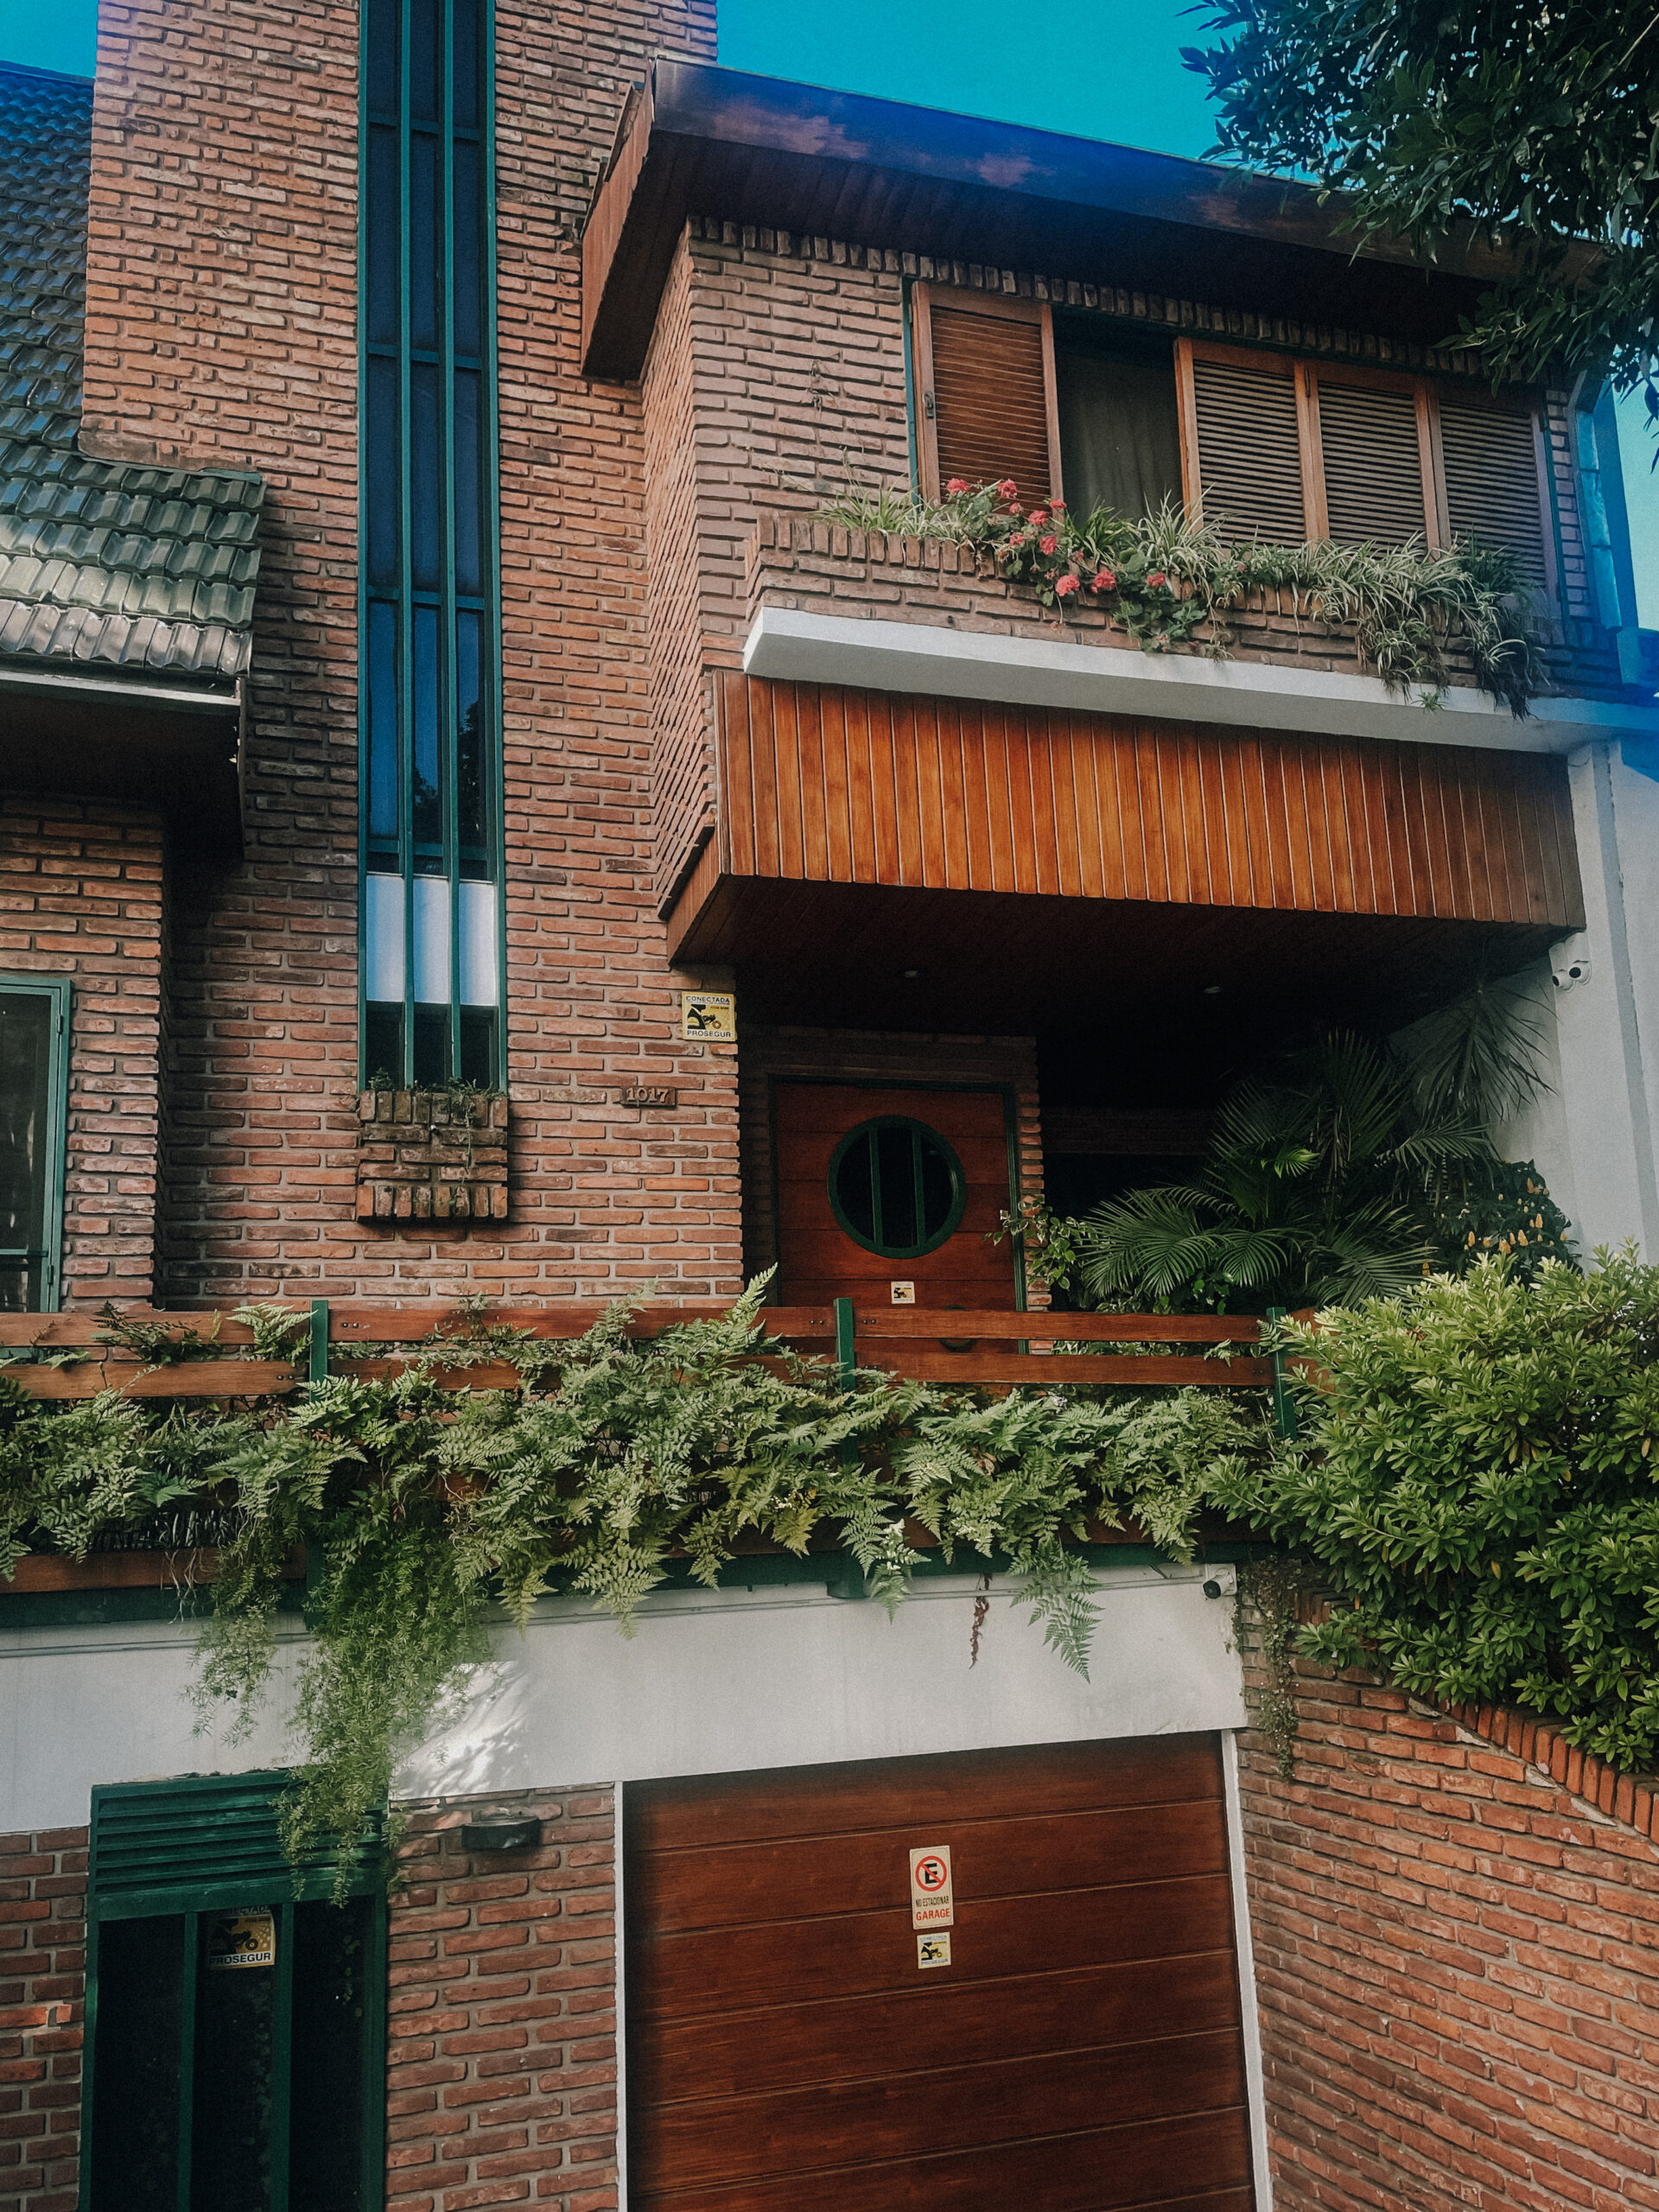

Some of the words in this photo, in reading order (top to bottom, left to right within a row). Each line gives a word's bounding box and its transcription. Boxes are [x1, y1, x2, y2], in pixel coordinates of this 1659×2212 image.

[626, 1087, 669, 1103] 1017
[925, 1863, 938, 1884] E
[916, 1898, 922, 1907] NO
[923, 1896, 949, 1907] ESTACIONAR
[916, 1909, 950, 1921] GARAGE
[209, 1953, 271, 1965] PROSEGUR
